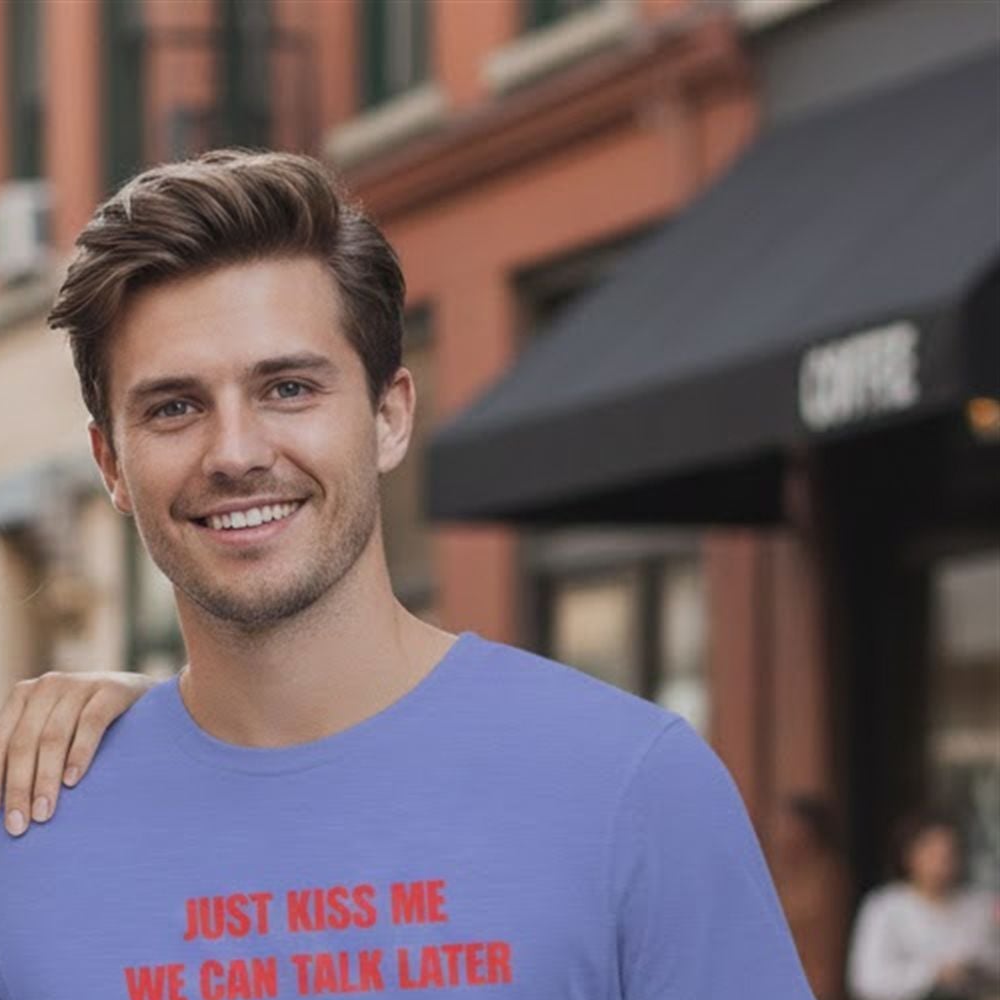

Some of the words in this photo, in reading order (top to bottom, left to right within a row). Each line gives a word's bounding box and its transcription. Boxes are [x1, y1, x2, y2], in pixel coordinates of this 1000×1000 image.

[183, 891, 274, 942] JUST
[286, 883, 378, 933] KISS
[389, 879, 449, 925] ME
[290, 948, 385, 997] TALK
[397, 940, 513, 990] LATER
